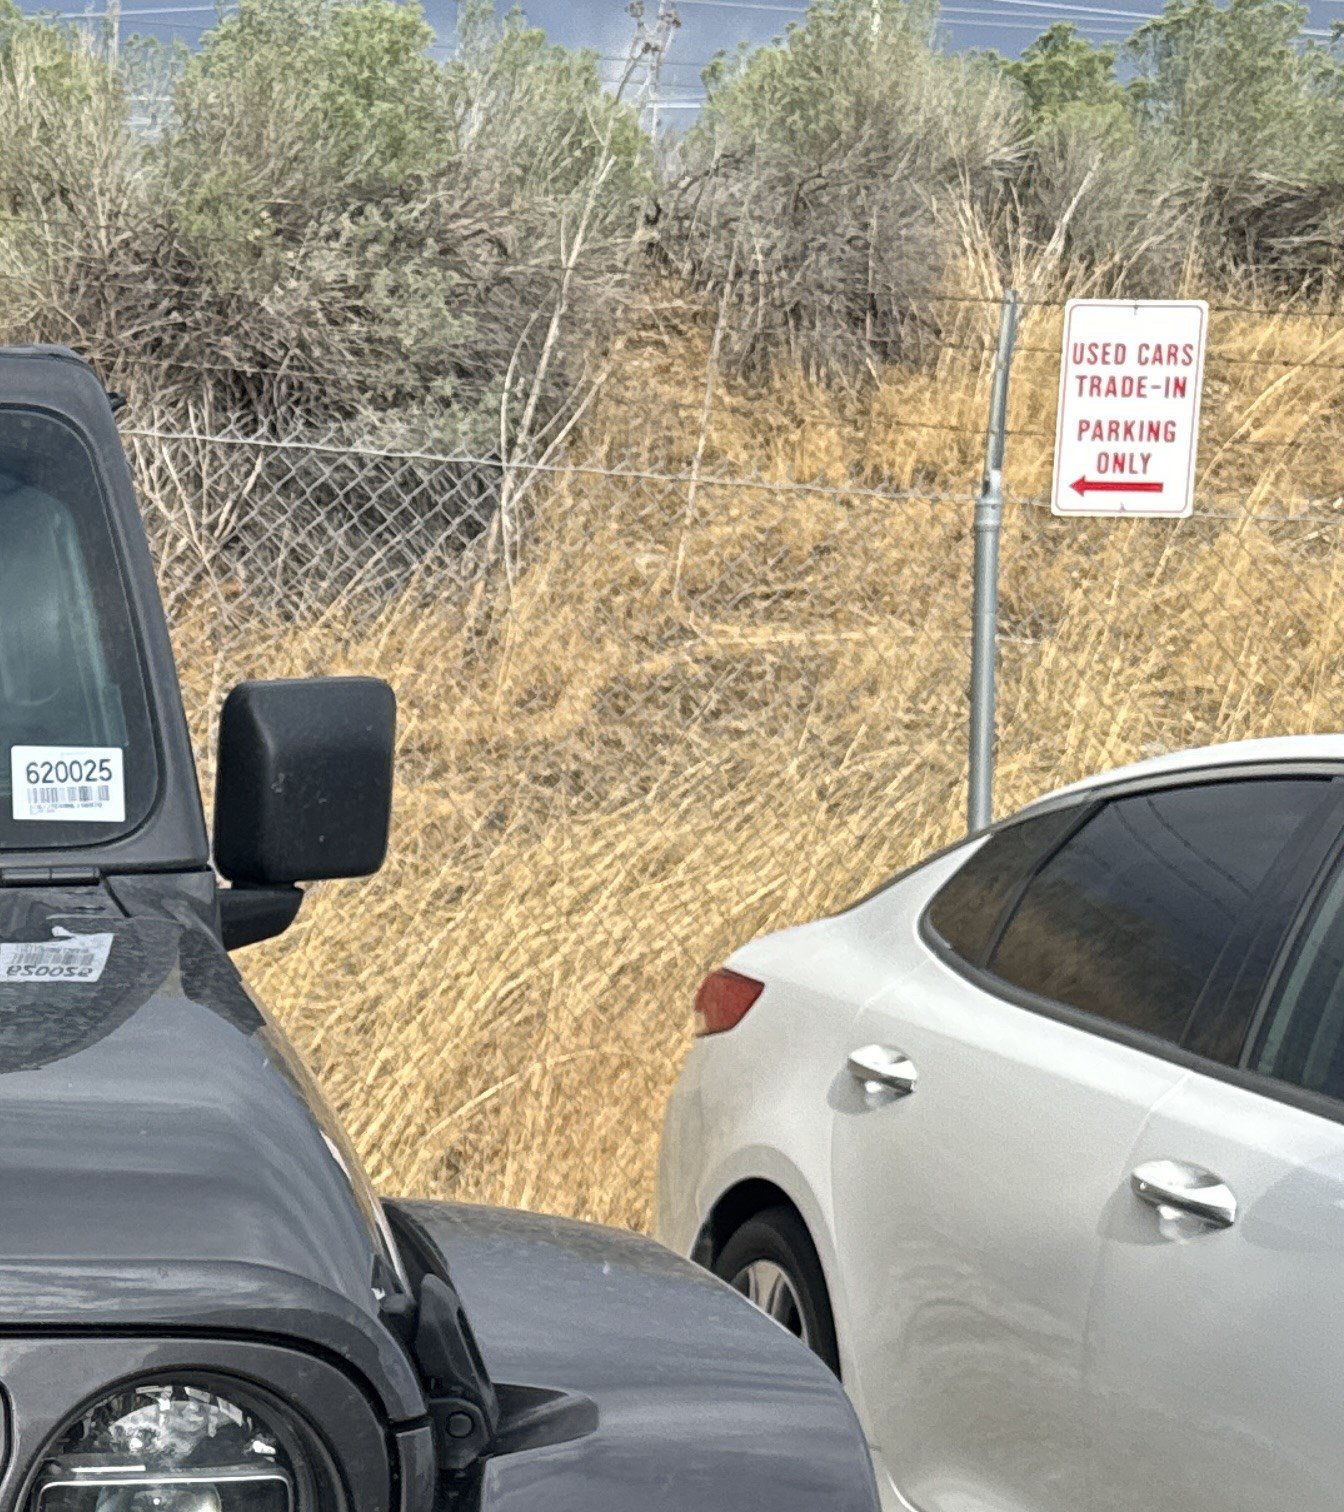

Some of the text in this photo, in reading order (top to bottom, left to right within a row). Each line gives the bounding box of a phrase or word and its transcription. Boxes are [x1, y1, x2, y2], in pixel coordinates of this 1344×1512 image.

[1072, 342, 1194, 366] USED CARS
[1075, 375, 1188, 399] TRADE-IN
[1077, 419, 1177, 443] PARKING
[1096, 452, 1152, 475] ONLY
[26, 758, 113, 784] 620025
